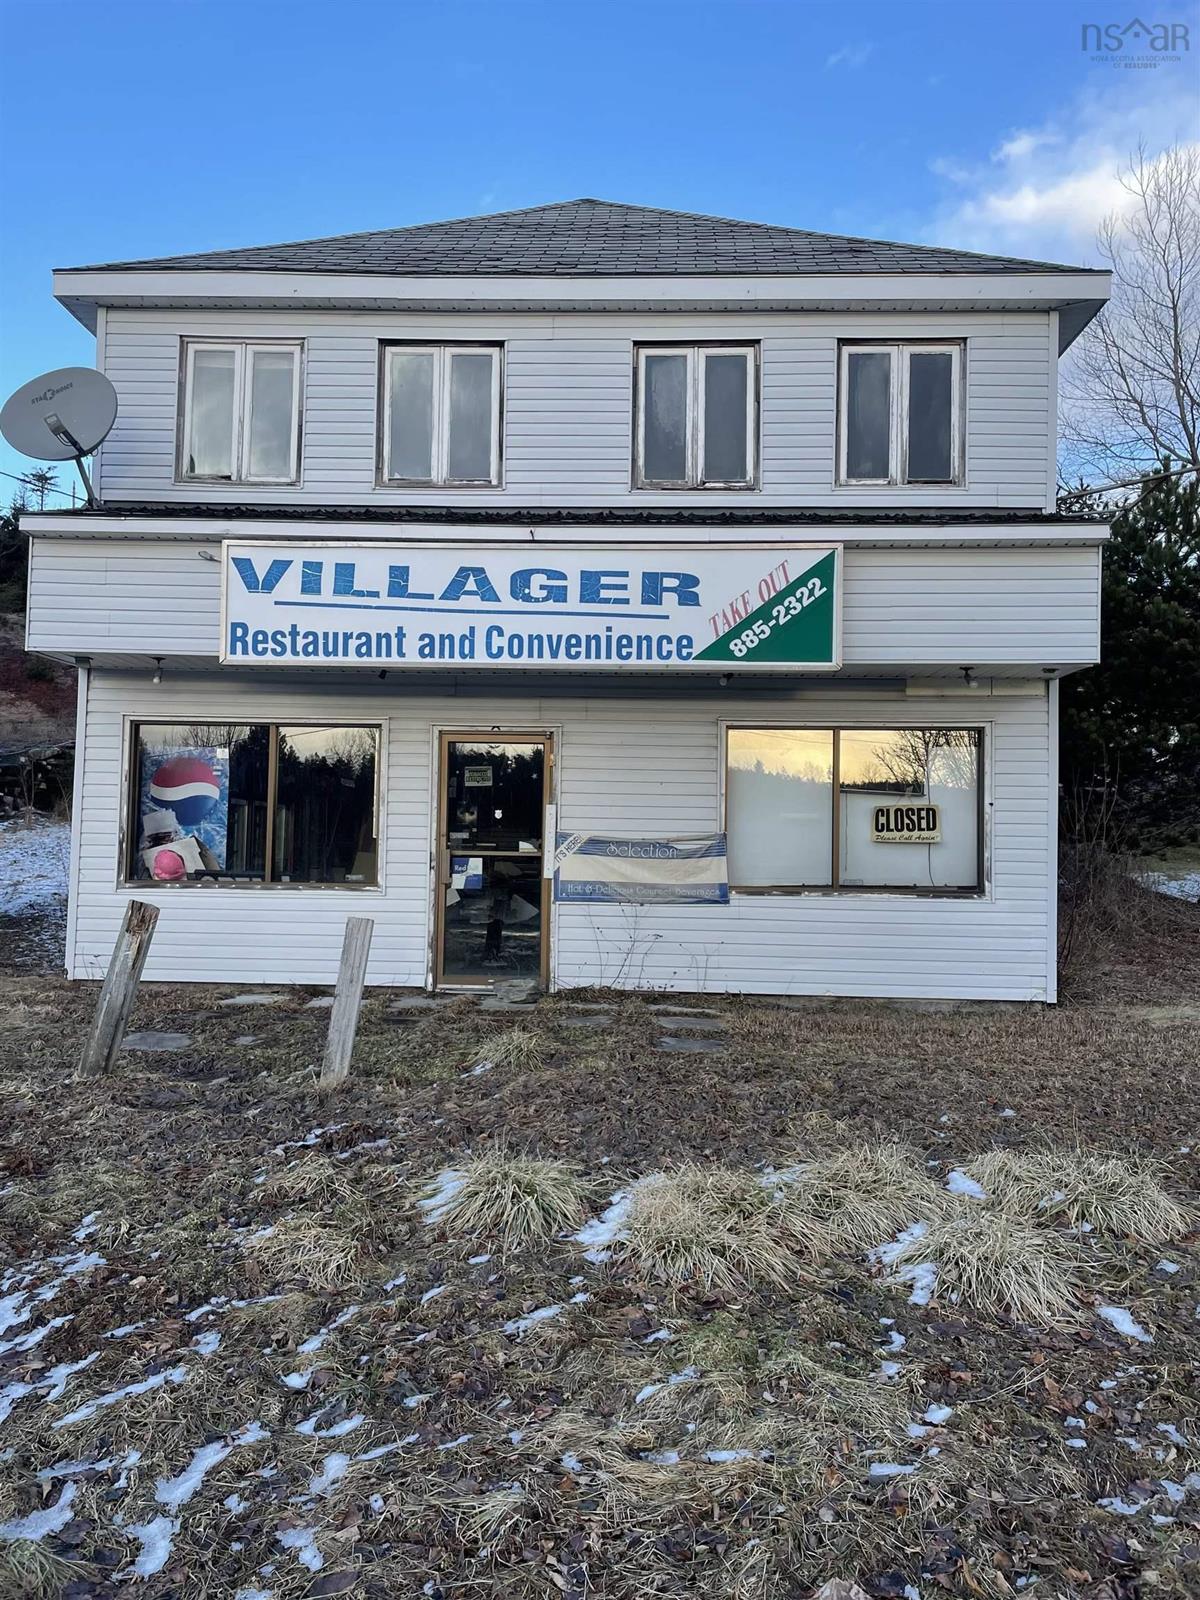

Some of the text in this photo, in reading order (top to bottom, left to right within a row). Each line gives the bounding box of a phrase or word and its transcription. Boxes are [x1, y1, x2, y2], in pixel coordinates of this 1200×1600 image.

[230, 556, 702, 607] VILLAGER
[709, 560, 792, 639] TAKE OUT
[729, 577, 828, 658] 885-2322
[230, 622, 693, 661] Restaurant and Convenience
[875, 807, 937, 832] CLOSED
[606, 841, 679, 858] Selection
